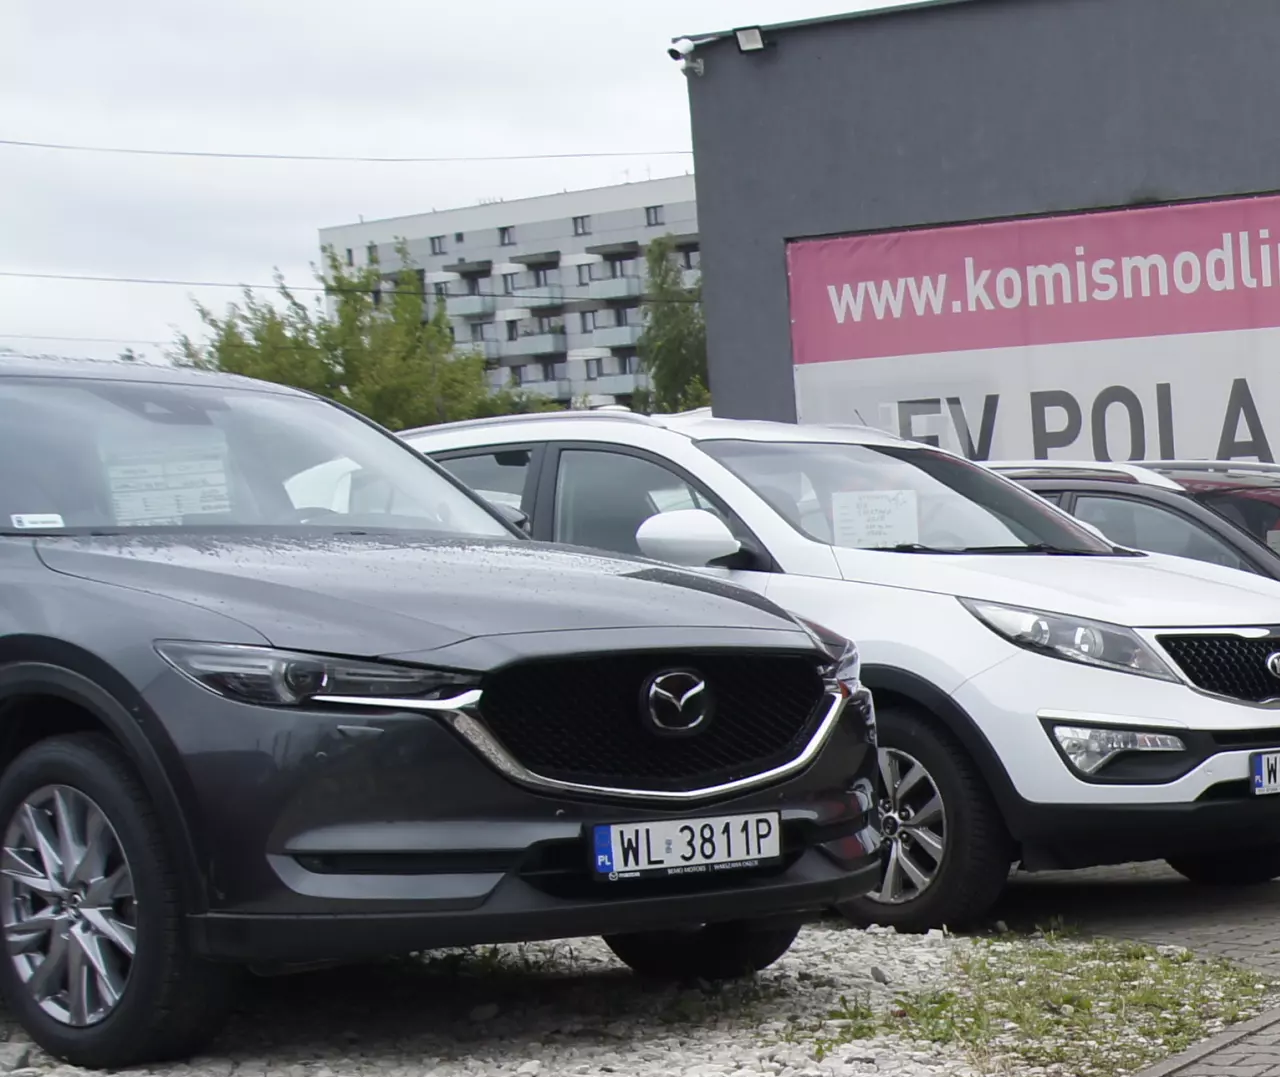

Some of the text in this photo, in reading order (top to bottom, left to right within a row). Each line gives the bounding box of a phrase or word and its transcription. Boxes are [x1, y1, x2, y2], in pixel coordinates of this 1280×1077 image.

[619, 818, 772, 868] WL 3811P
[598, 855, 611, 866] PL
